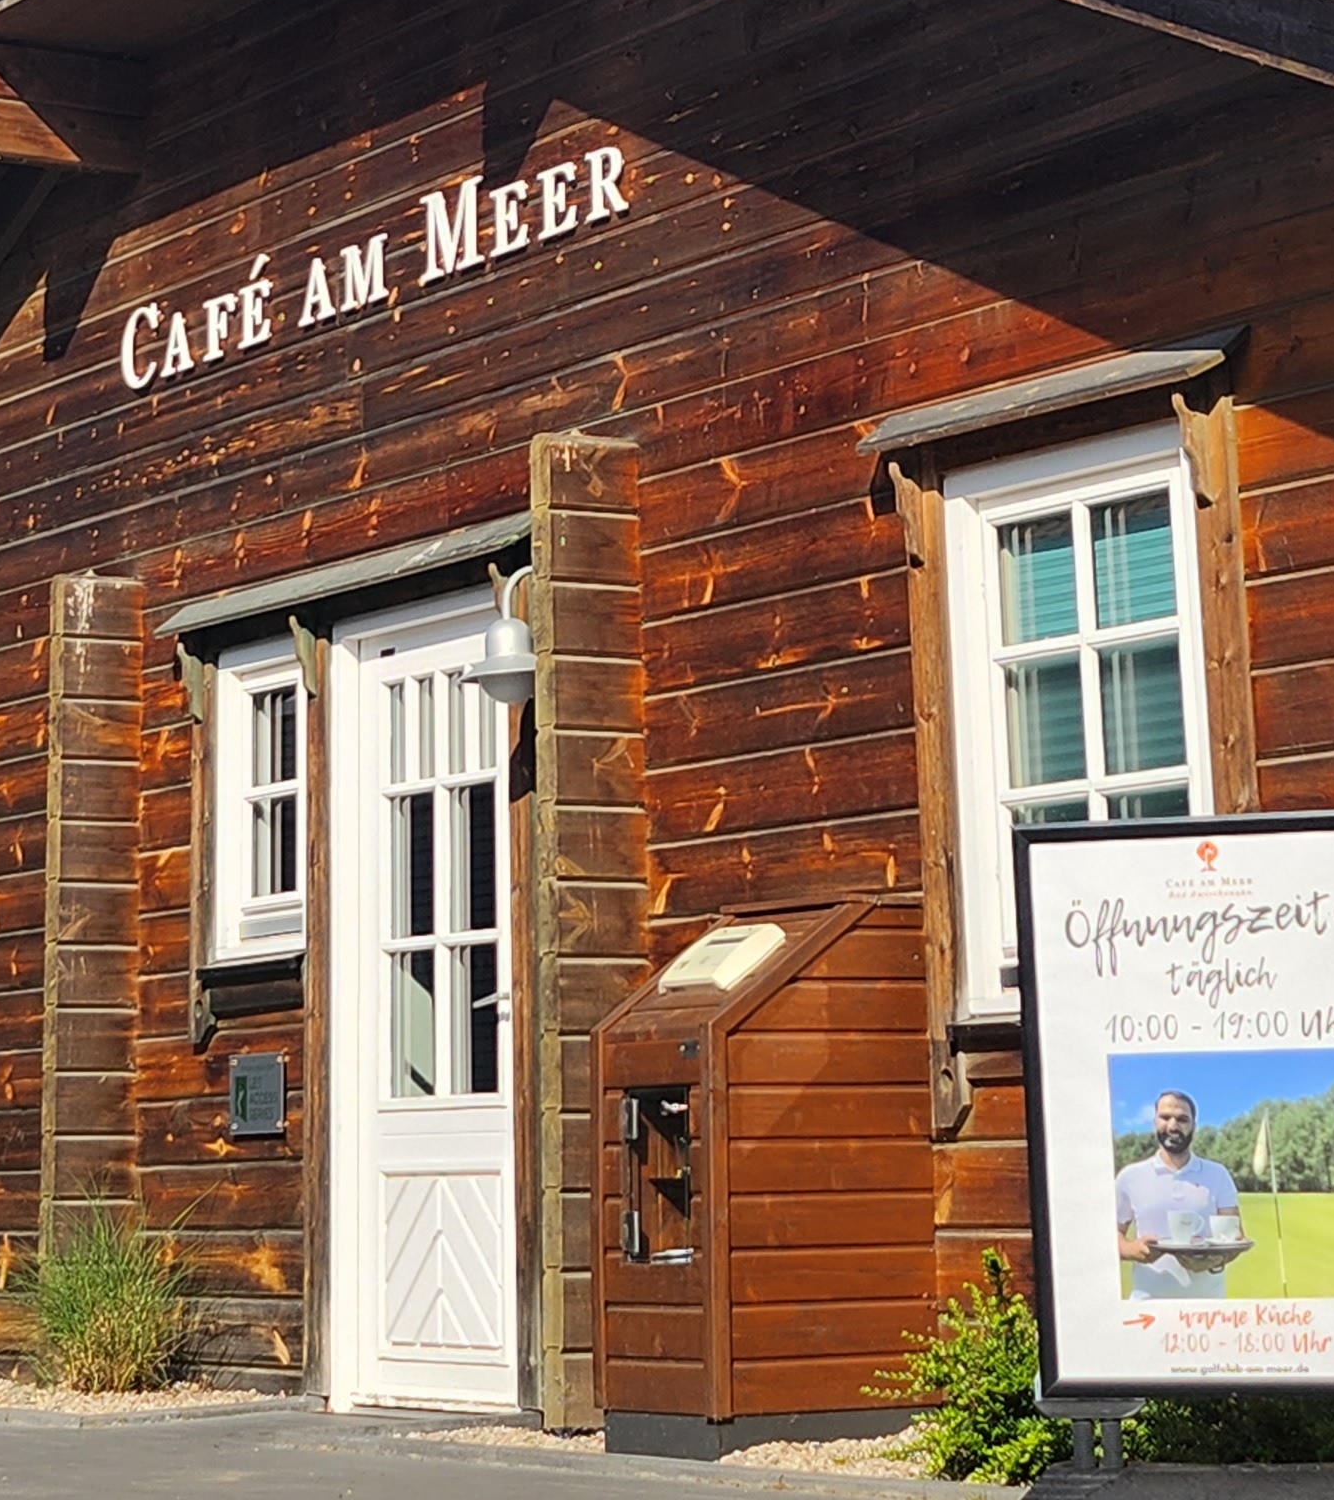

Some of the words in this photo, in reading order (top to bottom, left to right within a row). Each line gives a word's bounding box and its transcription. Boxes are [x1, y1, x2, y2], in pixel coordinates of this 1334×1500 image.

[120, 254, 274, 389] CAFÉ
[298, 233, 390, 328] AM
[419, 145, 630, 286] MEER
[1165, 956, 1278, 1009] täglich
[1105, 1013, 1179, 1044] 10:00
[1213, 1010, 1289, 1040] 19:00
[1179, 1309, 1248, 1329] warme
[1255, 1303, 1314, 1326] Küche
[1160, 1332, 1210, 1354] 12:00
[1235, 1332, 1286, 1353] 18:00
[1292, 1329, 1333, 1354] Uhr
